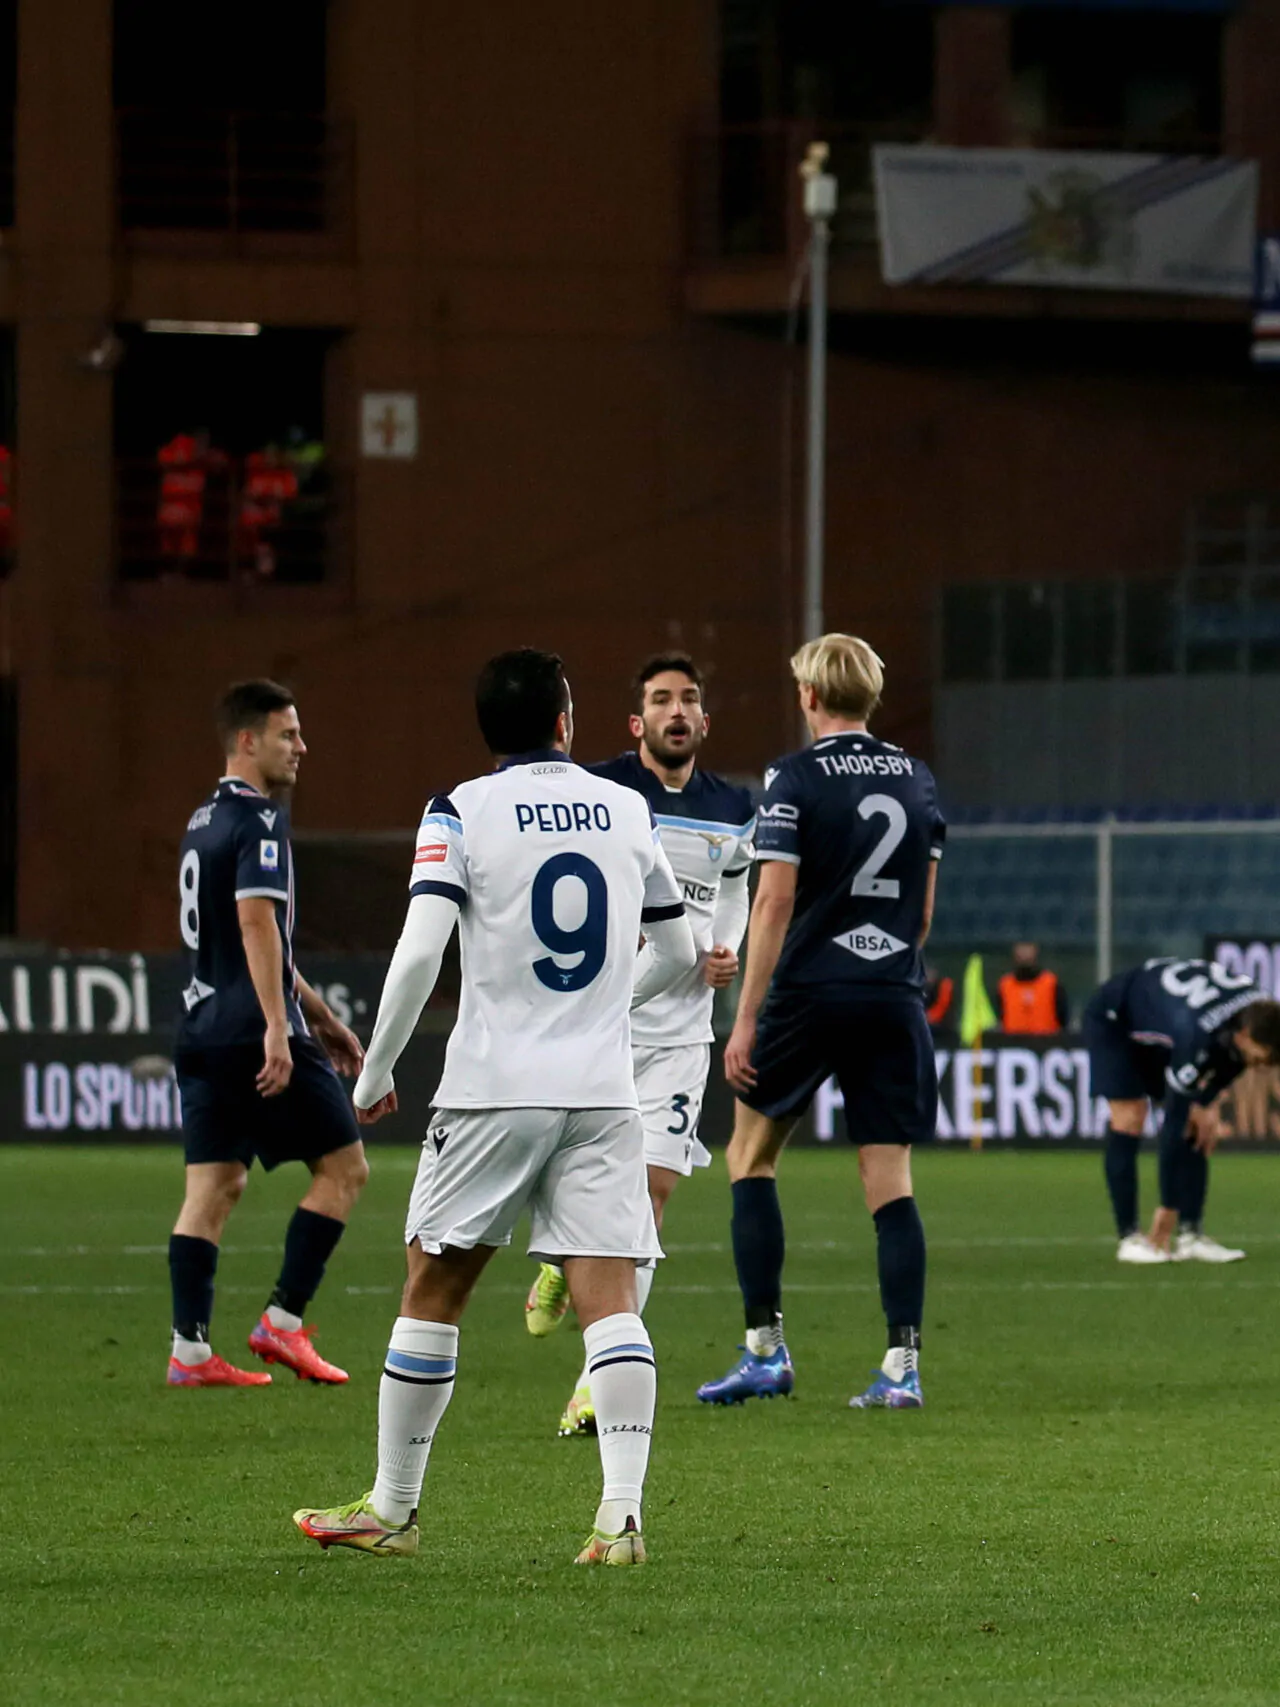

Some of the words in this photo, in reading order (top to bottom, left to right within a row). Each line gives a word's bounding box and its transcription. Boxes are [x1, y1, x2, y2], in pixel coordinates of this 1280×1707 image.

[816, 754, 914, 776] THORSBY
[515, 802, 611, 832] PEDRO
[851, 793, 908, 899] 2
[179, 849, 200, 950] 8
[531, 851, 609, 992] 9
[849, 934, 893, 952] IBSA
[24, 1062, 71, 1131] LO
